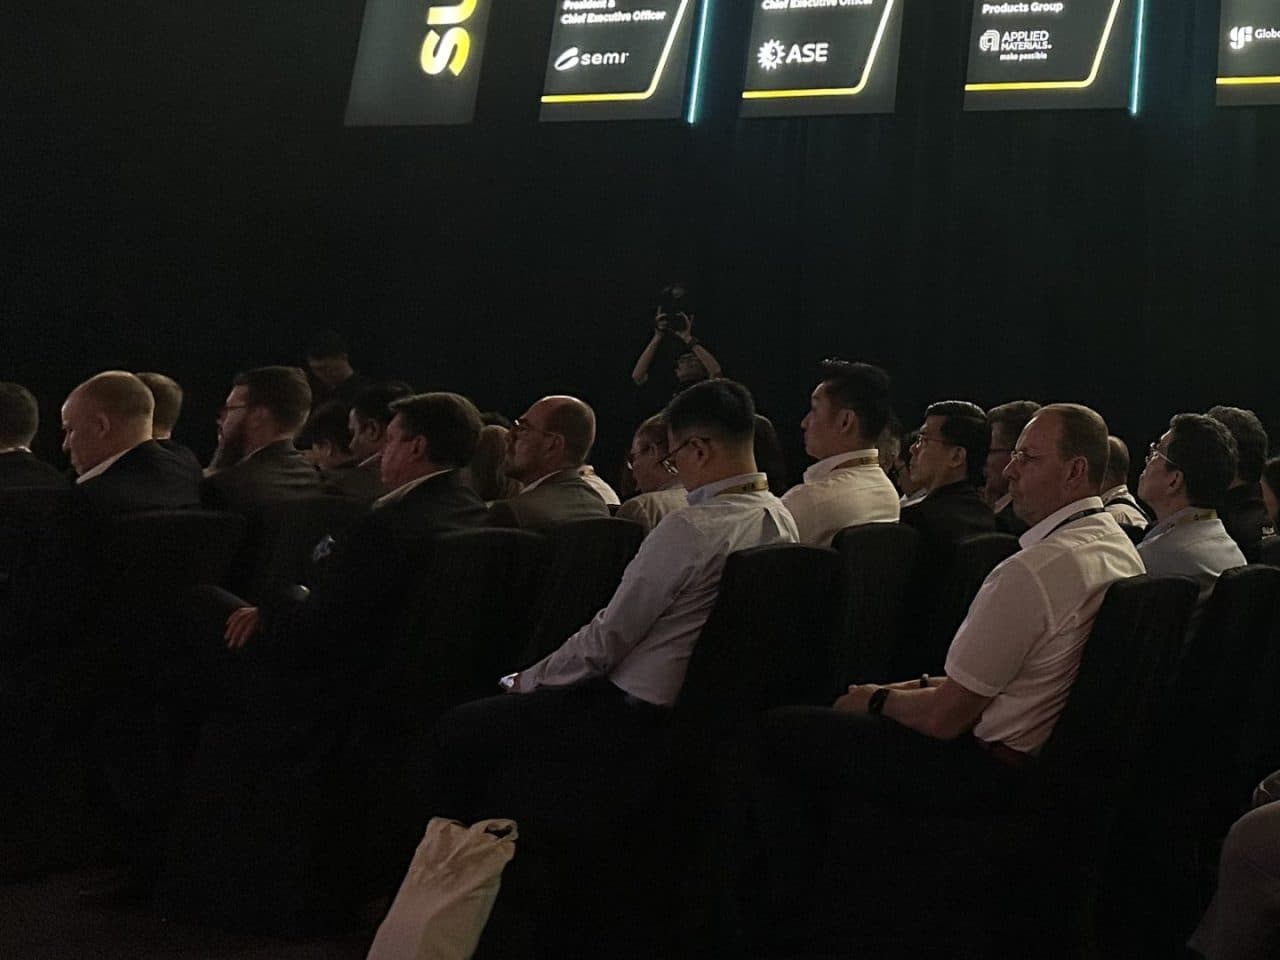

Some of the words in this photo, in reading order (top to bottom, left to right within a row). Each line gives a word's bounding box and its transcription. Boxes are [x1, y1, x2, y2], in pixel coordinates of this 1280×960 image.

[761, 0, 788, 10] Chief
[982, 2, 1029, 15] Products
[1030, 1, 1064, 14] Group
[560, 14, 587, 25] Chief
[587, 11, 631, 23] Executive
[633, 9, 667, 21] Officer
[1002, 30, 1049, 41] APPLIED
[785, 42, 829, 64] ASE
